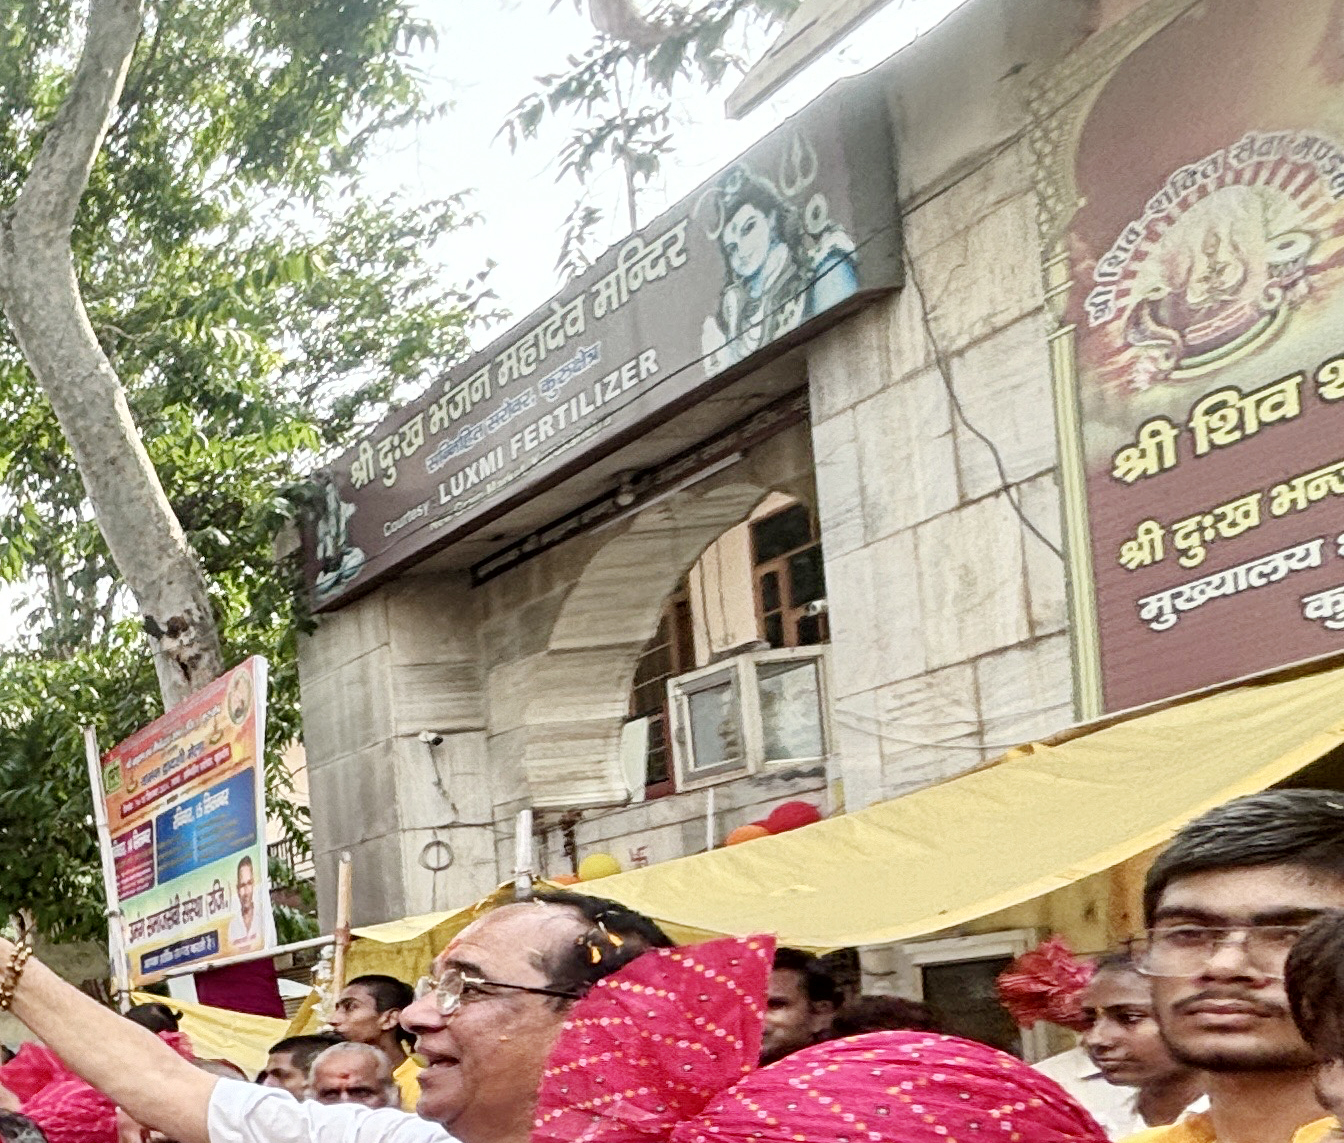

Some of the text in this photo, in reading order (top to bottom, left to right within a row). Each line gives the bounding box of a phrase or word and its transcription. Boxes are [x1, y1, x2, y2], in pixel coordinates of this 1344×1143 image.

[350, 219, 689, 489] श्री दुःख भंजन महादेव मन्दिर
[383, 348, 660, 537] Courtesy LUXMI FERTILIZER
[1112, 419, 1179, 483] श्री
[1188, 373, 1303, 456] शिव
[1119, 519, 1165, 570] श्री
[1171, 492, 1262, 568] दुःख
[1137, 538, 1326, 631] मुख्यालय
